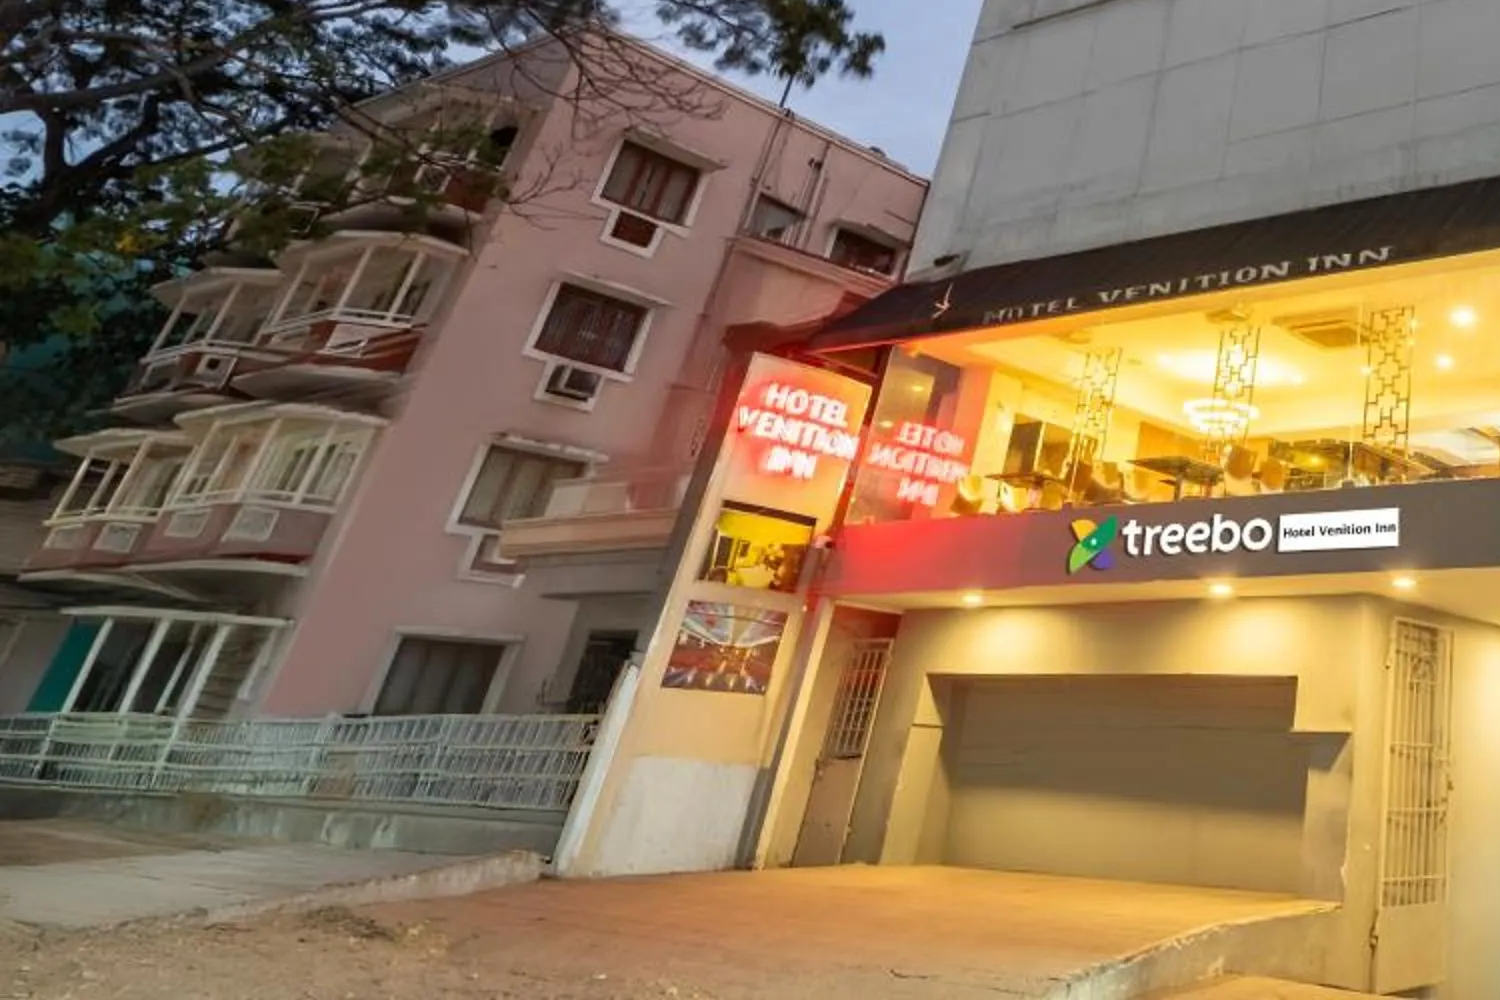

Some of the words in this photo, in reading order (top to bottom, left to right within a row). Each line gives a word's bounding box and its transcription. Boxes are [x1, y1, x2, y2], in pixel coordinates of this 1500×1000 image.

[982, 296, 1082, 326] HOTEL
[1096, 260, 1292, 304] VENITION
[1307, 245, 1396, 272] INN
[765, 382, 849, 428] HOTEL
[737, 404, 860, 462] VENITION
[1121, 513, 1274, 556] treebo
[1282, 524, 1316, 539] Hotel
[1319, 523, 1372, 538] Venition
[1375, 522, 1398, 535] Inn
